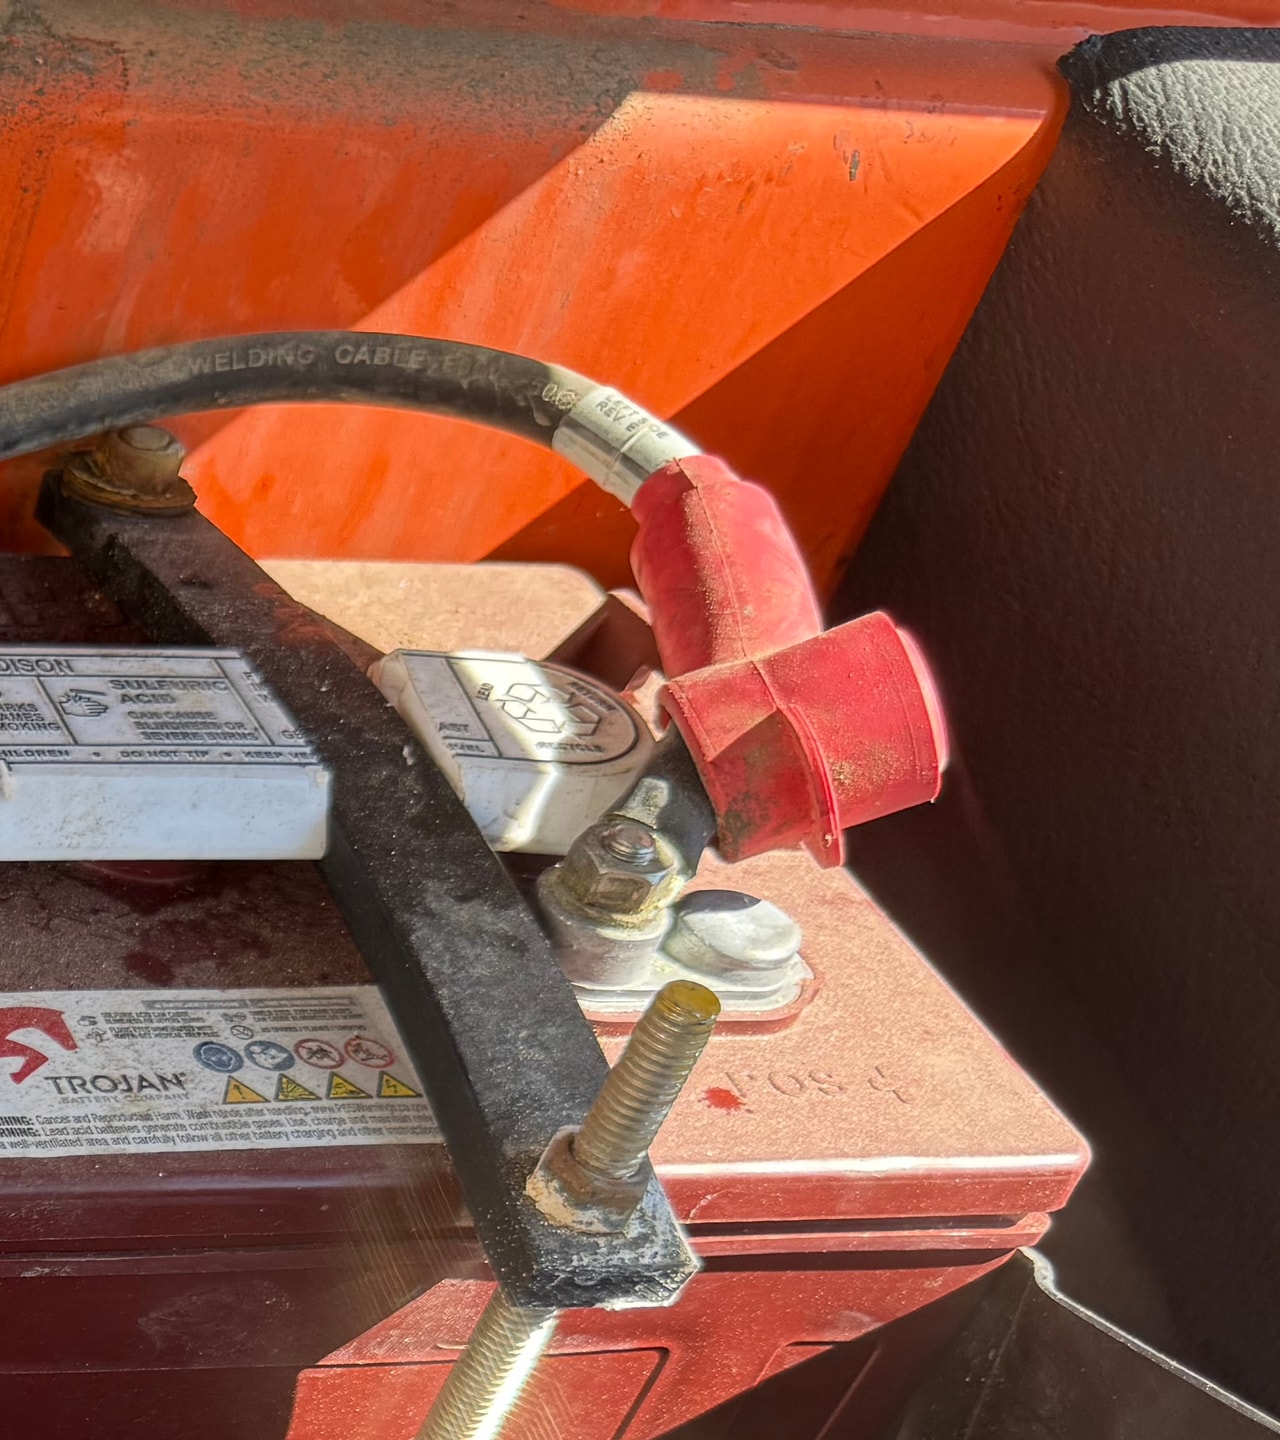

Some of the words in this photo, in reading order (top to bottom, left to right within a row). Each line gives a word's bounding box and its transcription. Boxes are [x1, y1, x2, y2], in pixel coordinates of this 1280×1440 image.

[190, 347, 315, 374] WELDING
[335, 345, 427, 369] CABLE
[638, 417, 670, 439] SDE
[108, 680, 229, 691] SULFURIC
[120, 693, 176, 704] ACID
[242, 751, 283, 759] KEEP
[43, 1073, 185, 1095] TROJAN
[41, 1126, 69, 1137] Lead
